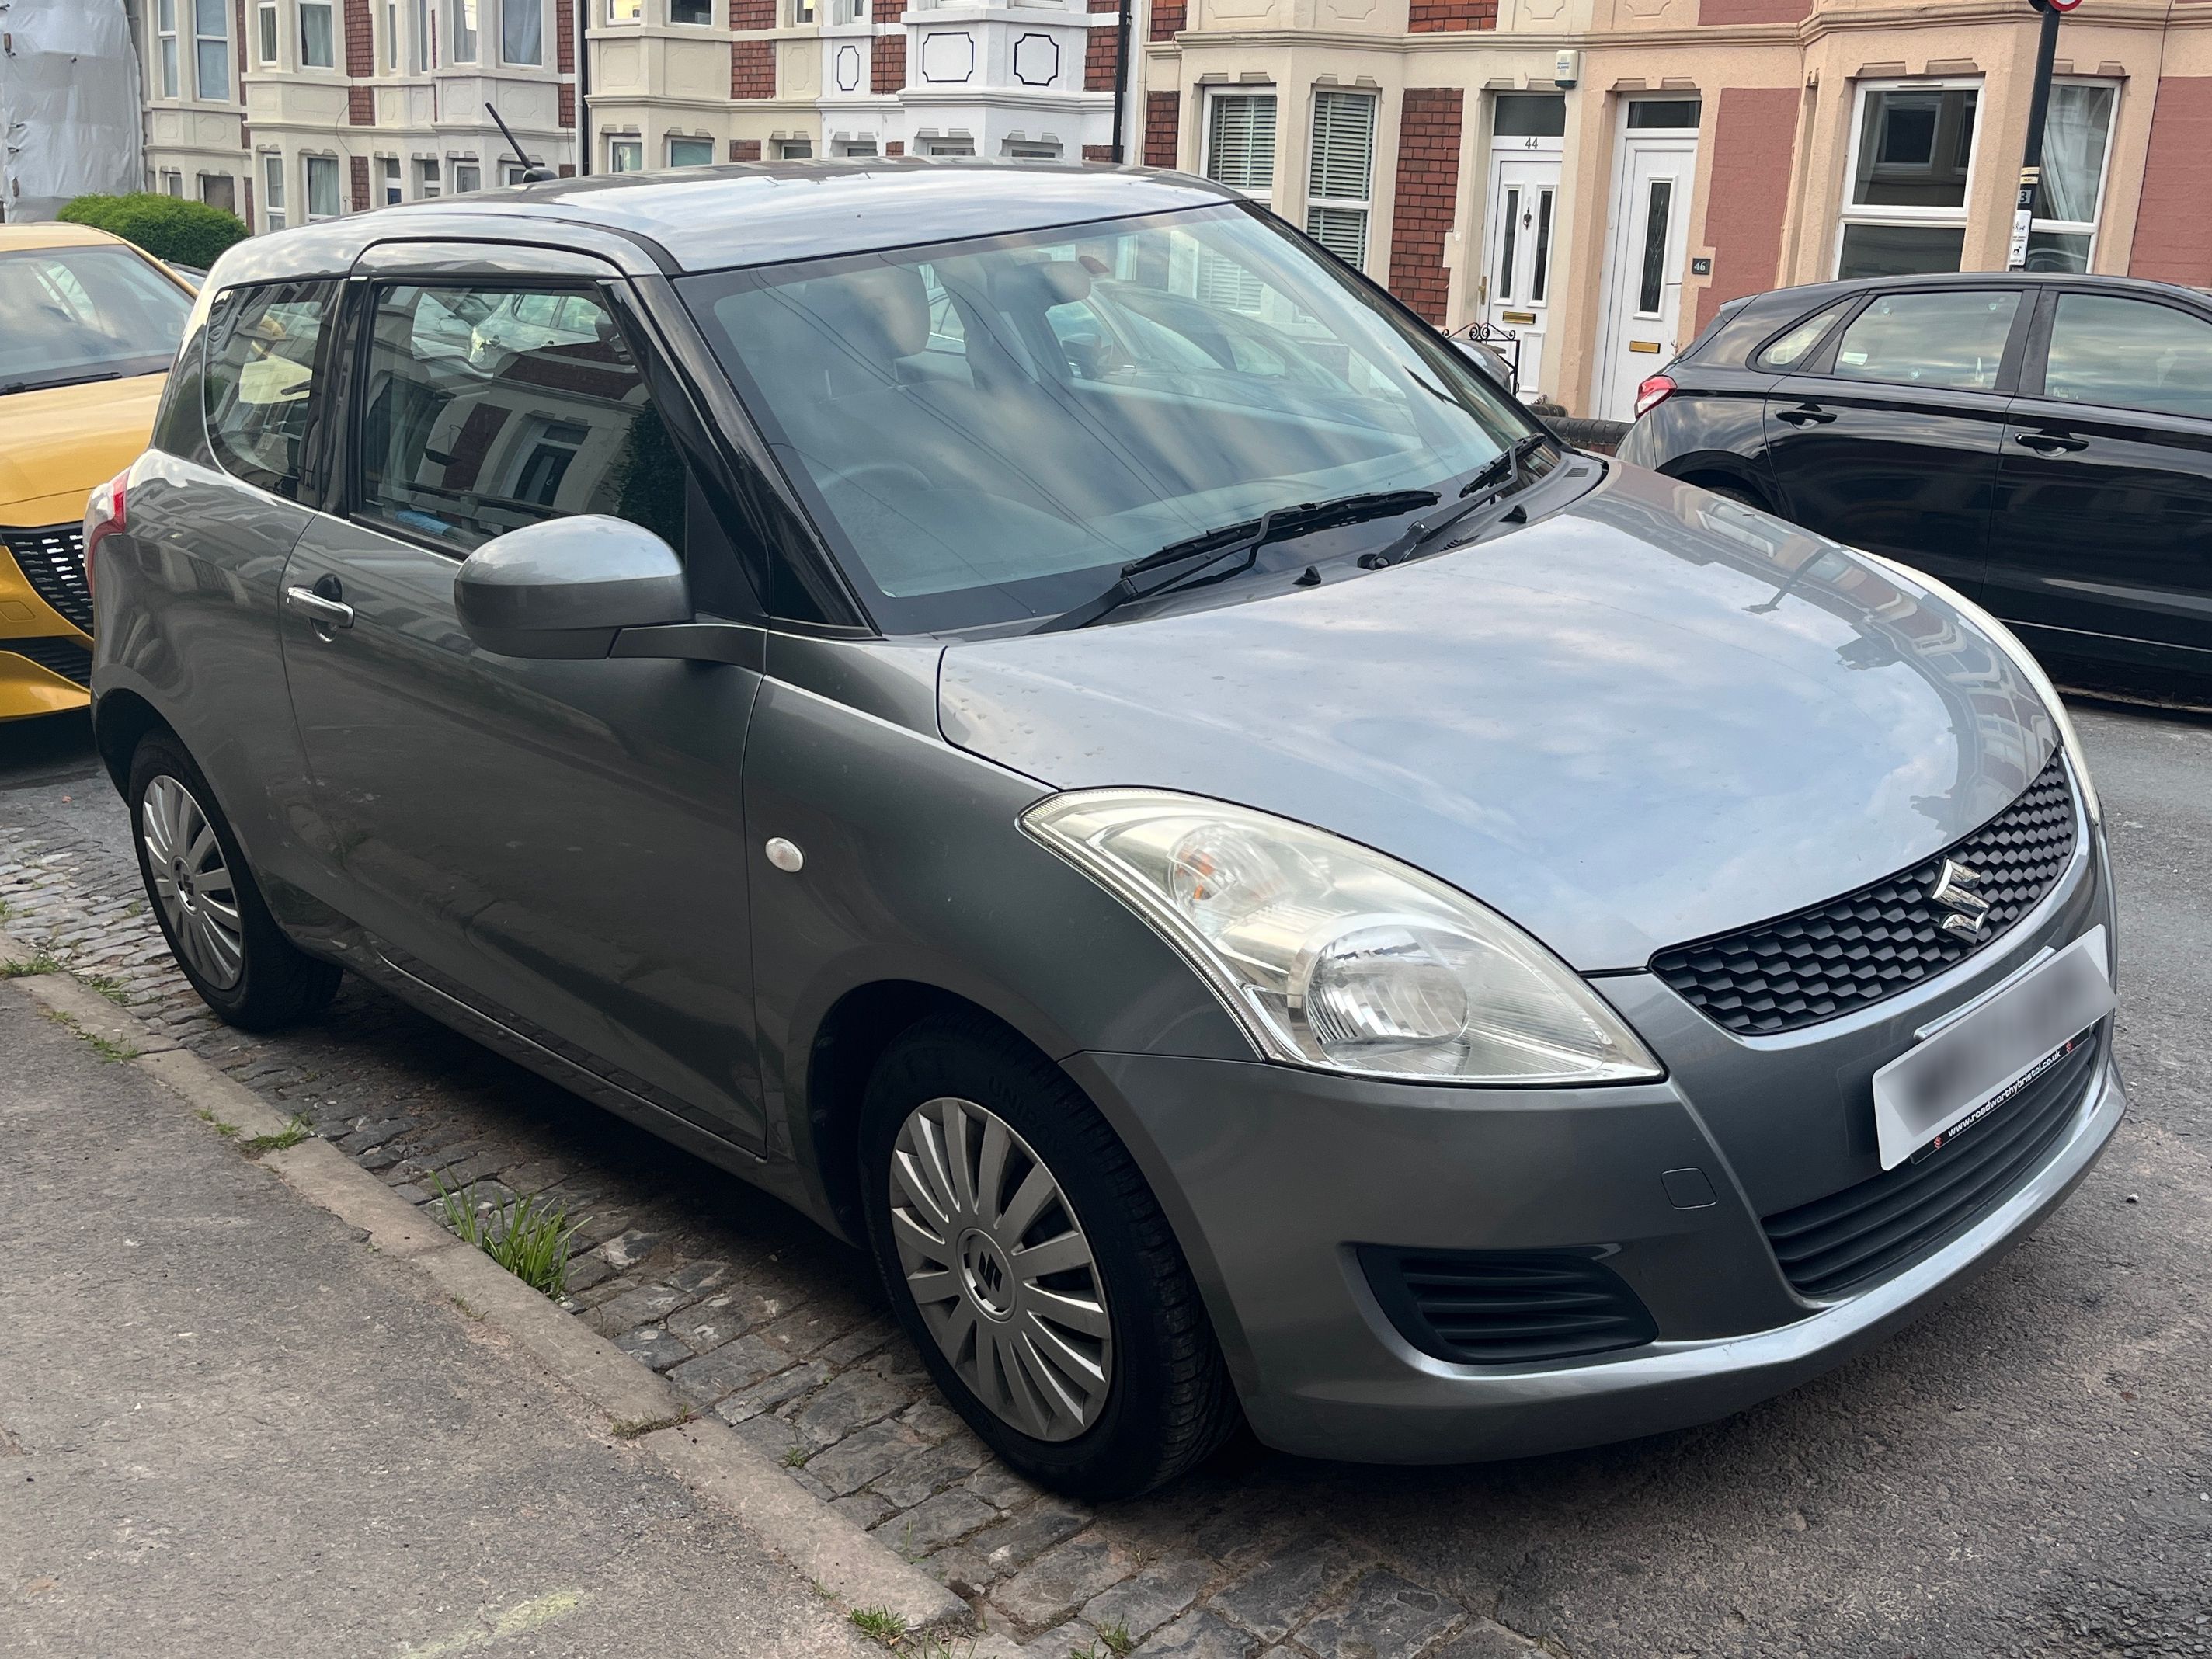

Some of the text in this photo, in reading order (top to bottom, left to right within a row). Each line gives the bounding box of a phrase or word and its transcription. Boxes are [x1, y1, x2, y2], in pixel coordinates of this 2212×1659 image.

[1525, 137, 1538, 149] 44
[1693, 261, 1706, 271] 46
[1948, 1050, 2061, 1137] www.roadworthybristol.co.uk
